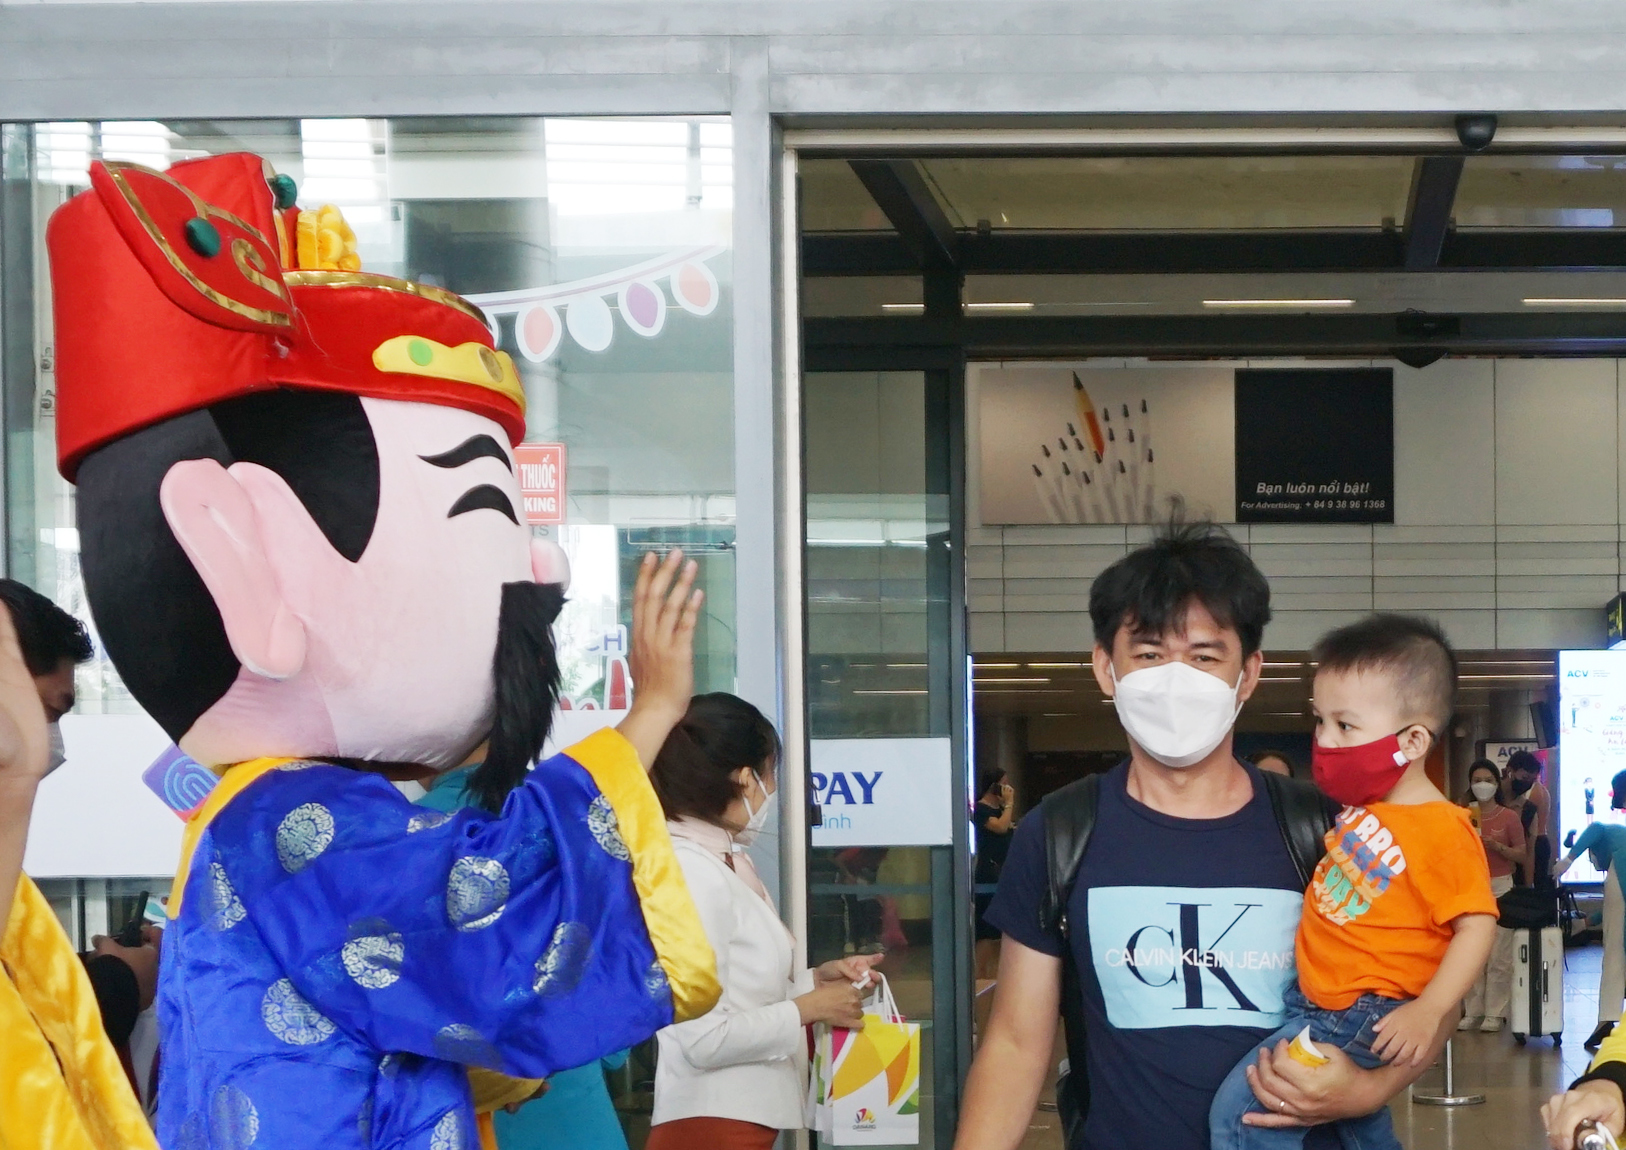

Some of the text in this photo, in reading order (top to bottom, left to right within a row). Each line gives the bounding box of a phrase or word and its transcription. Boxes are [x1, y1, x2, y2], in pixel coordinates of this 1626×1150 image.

[521, 454, 556, 489] THUỐC
[1256, 480, 1370, 496] Bạn luôn nổi bật!
[1313, 500, 1325, 509] 84
[1567, 670, 1589, 678] ACV
[1105, 948, 1174, 968] CALVIN
[1180, 948, 1234, 968] KLEIN
[1126, 903, 1279, 1015] CK
